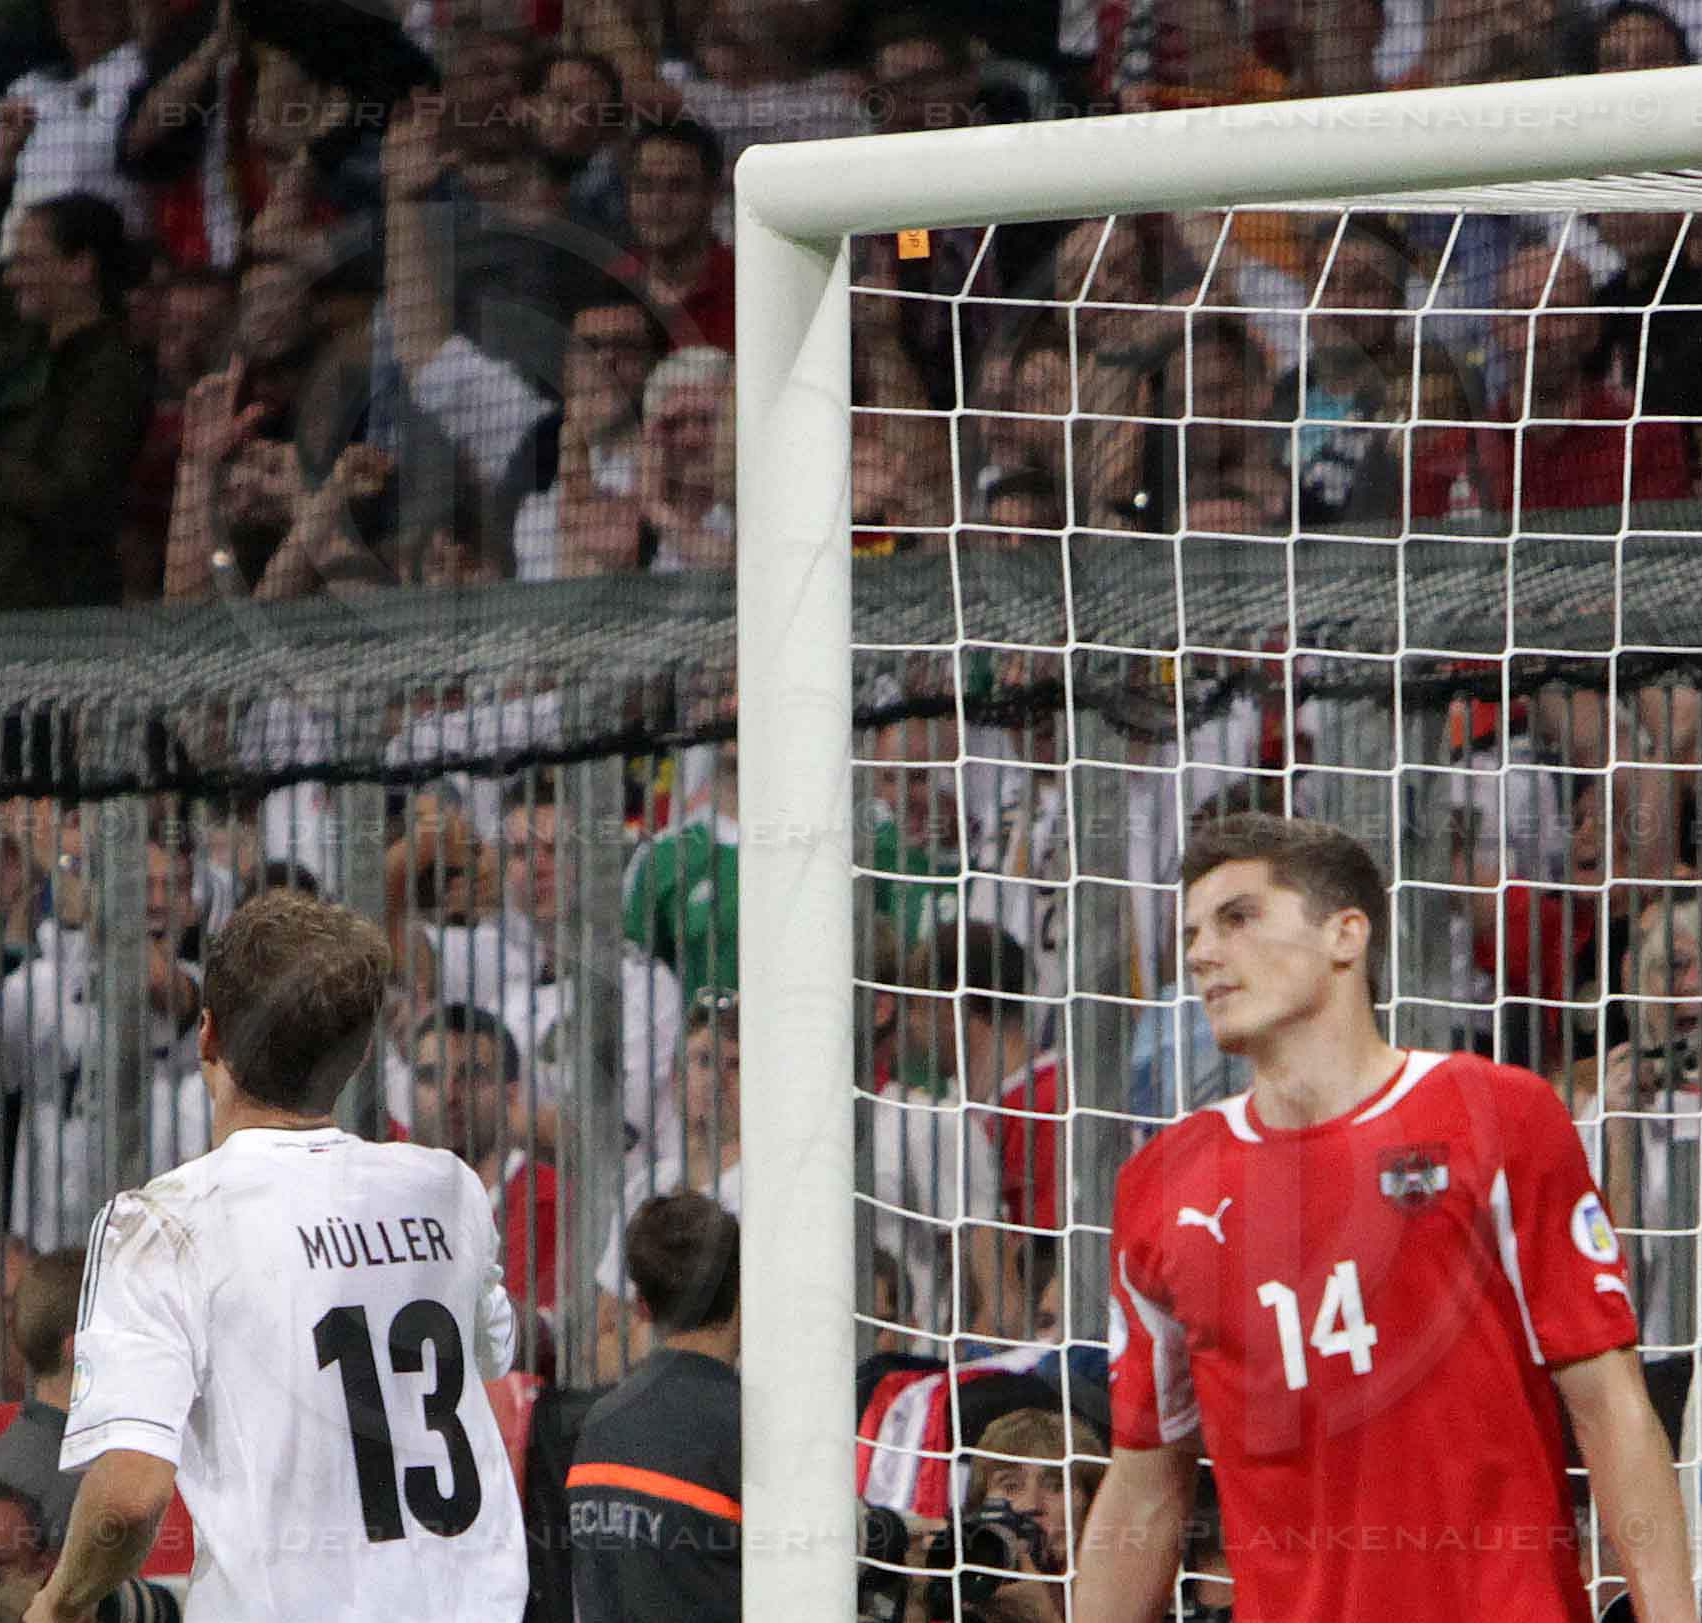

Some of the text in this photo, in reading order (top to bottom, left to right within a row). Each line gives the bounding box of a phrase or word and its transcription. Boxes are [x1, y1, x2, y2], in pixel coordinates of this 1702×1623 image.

[298, 1215, 454, 1271] MÜLLER
[1256, 1260, 1378, 1391] 14
[313, 1299, 483, 1544] 13
